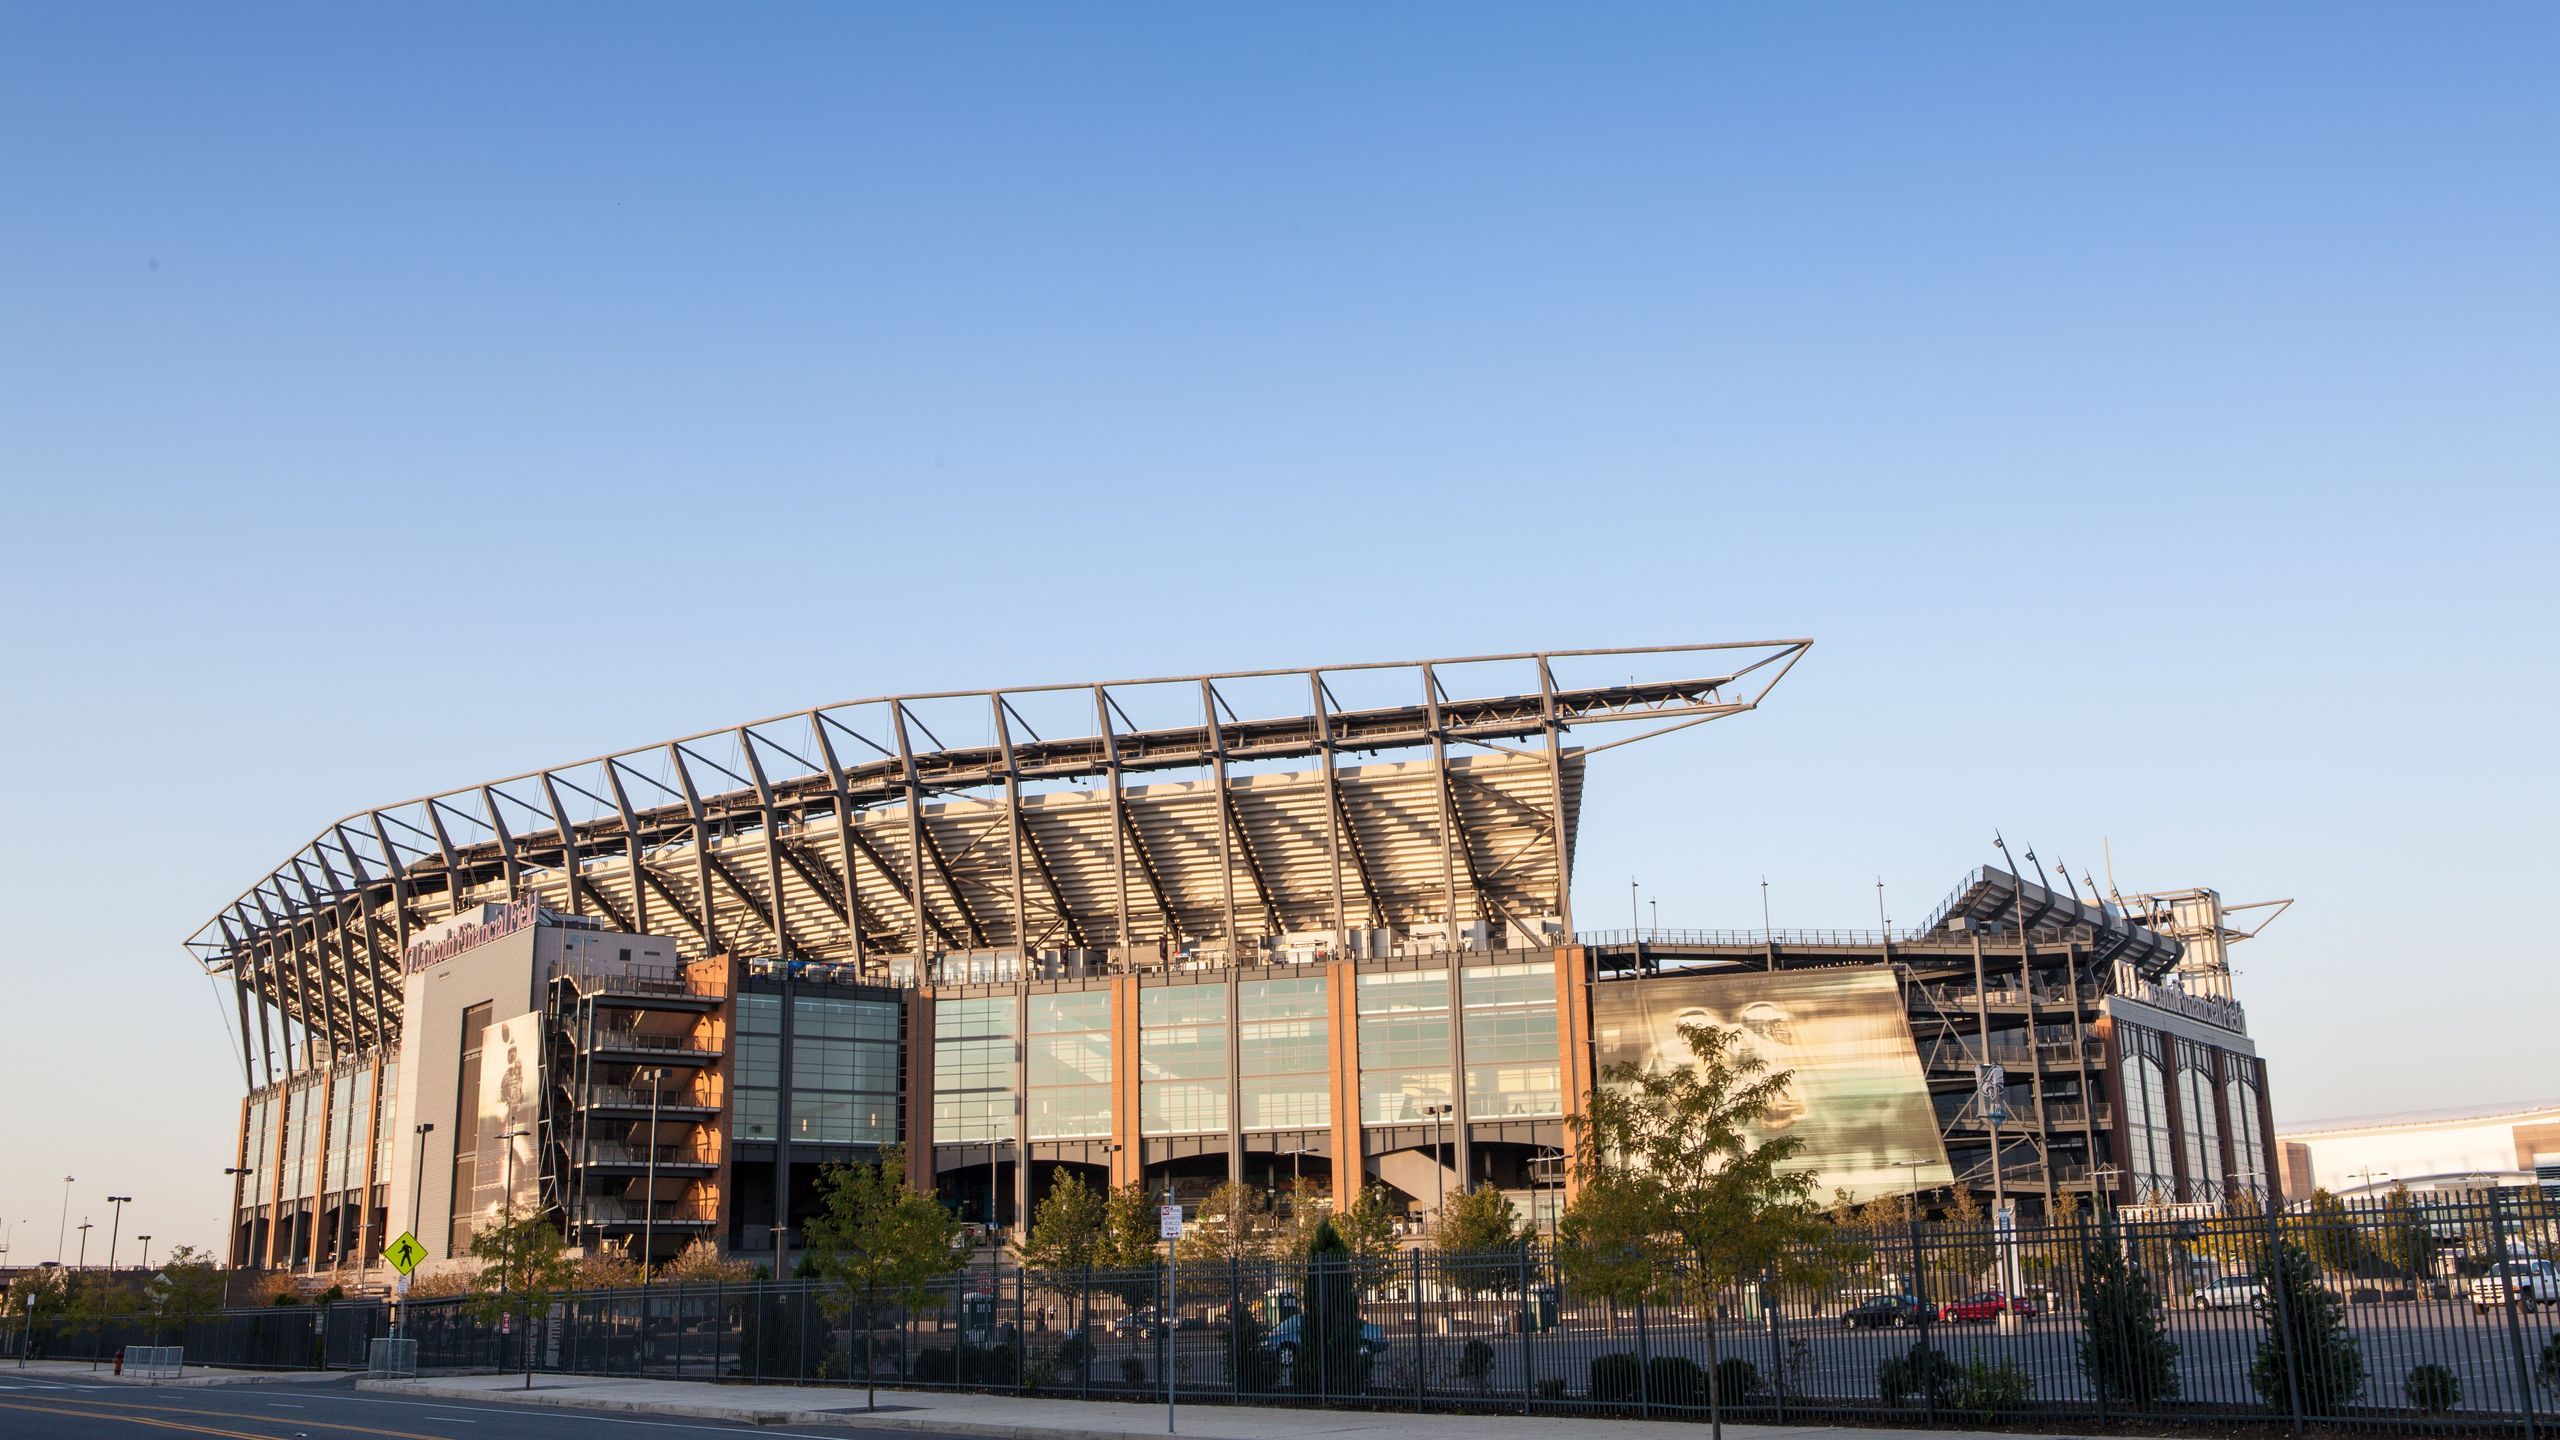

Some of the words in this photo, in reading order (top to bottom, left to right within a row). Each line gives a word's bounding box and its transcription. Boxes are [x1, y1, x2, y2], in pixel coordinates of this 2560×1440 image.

[414, 937, 455, 970] Lincoln
[455, 904, 508, 953] Financial
[508, 890, 538, 933] Field
